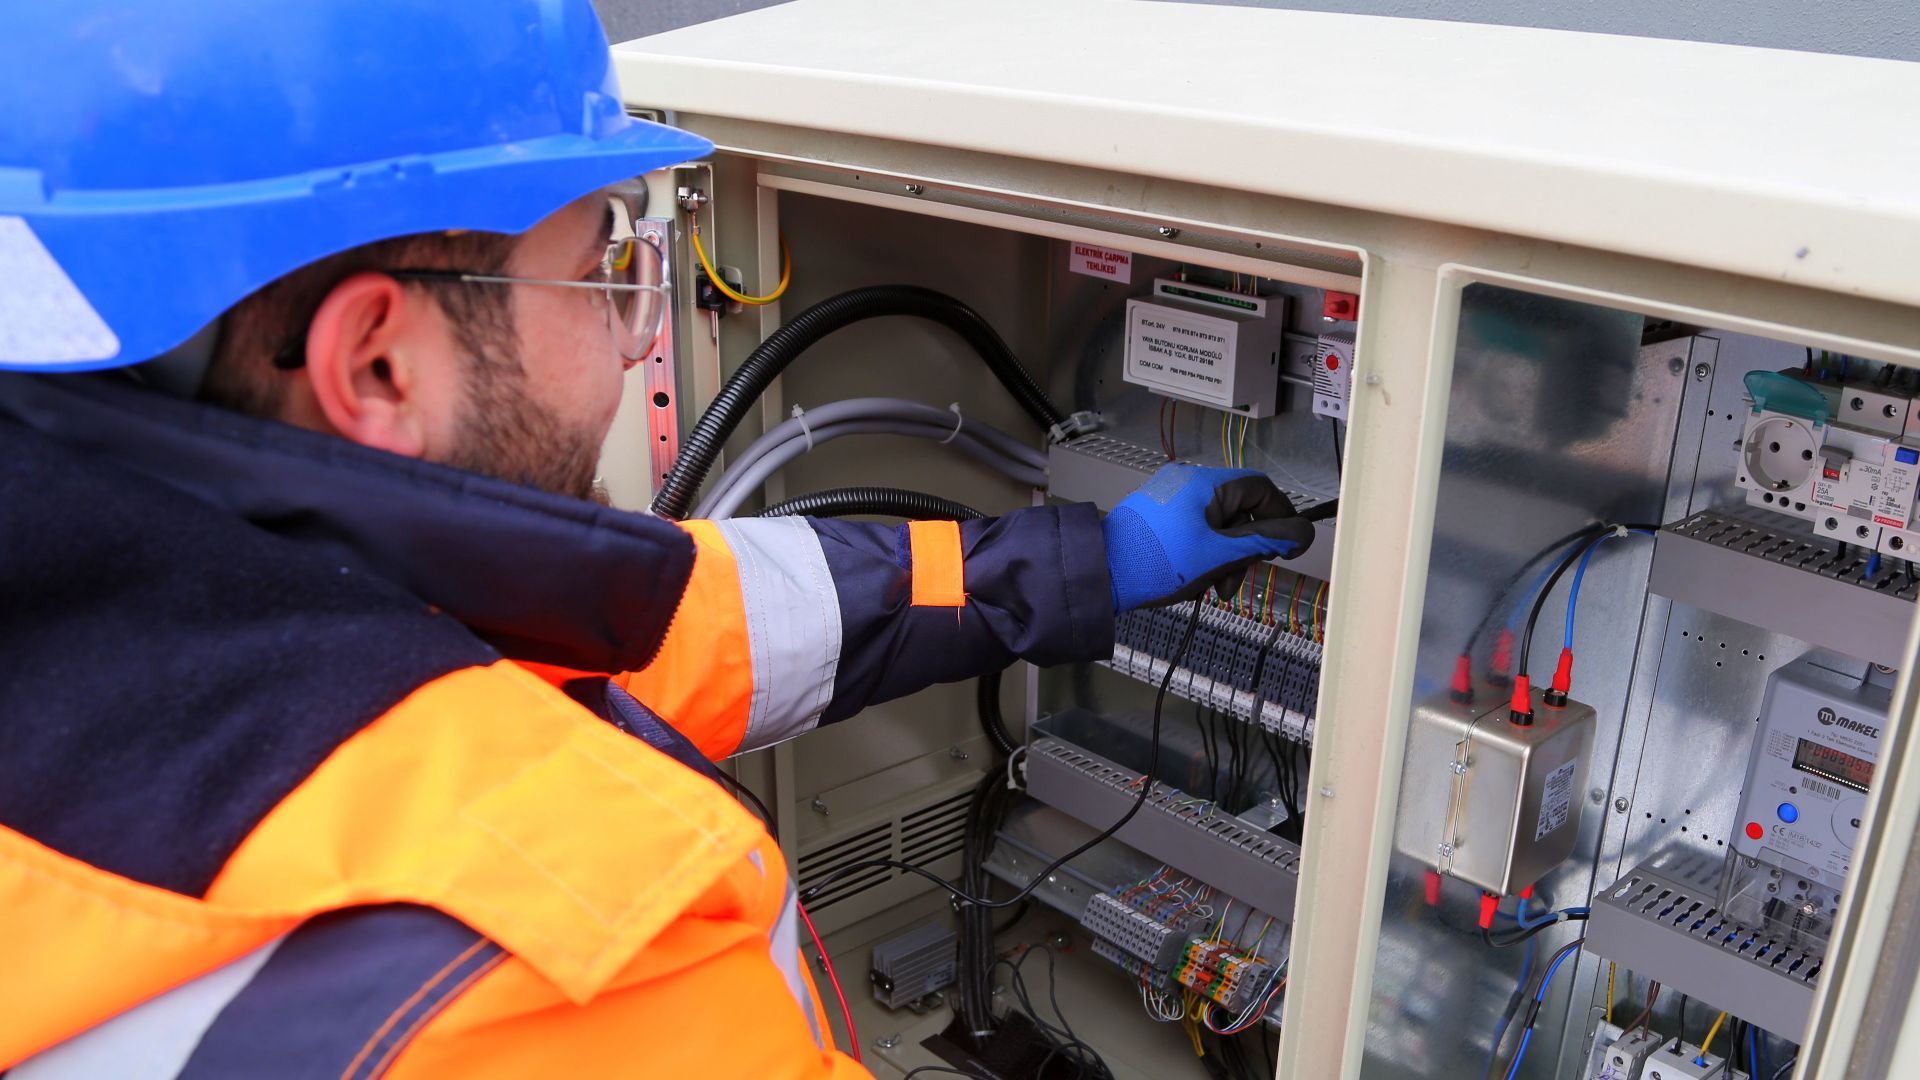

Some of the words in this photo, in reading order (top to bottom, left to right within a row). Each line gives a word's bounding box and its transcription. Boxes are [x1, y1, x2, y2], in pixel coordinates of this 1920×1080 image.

[1104, 252, 1129, 264] ÇARPMA
[1154, 338, 1176, 349] BUTONU
[1817, 486, 1829, 496] 25A
